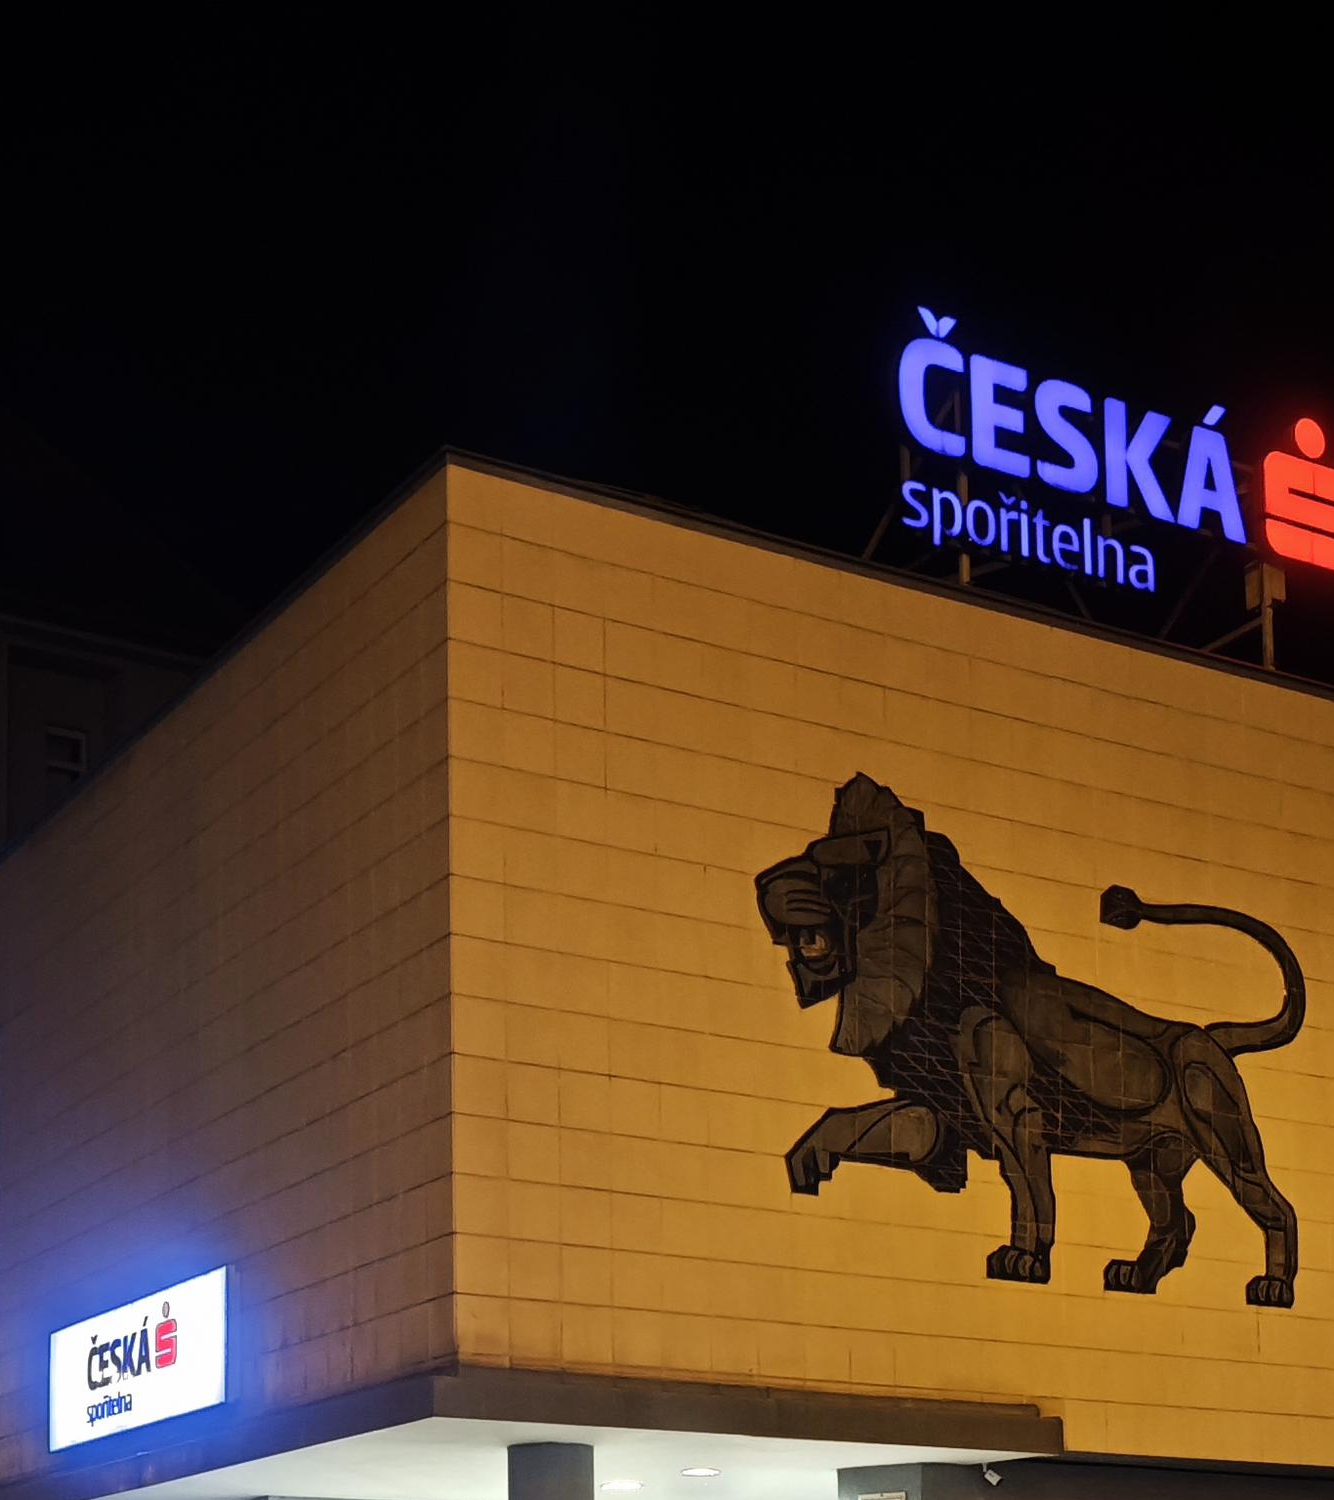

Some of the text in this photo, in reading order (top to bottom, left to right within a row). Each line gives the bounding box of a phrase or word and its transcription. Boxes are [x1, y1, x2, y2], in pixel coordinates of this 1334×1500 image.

[898, 305, 1247, 545] ČESKÁ
[901, 479, 1157, 593] spořitelna
[87, 1315, 151, 1391] ČESKÁ
